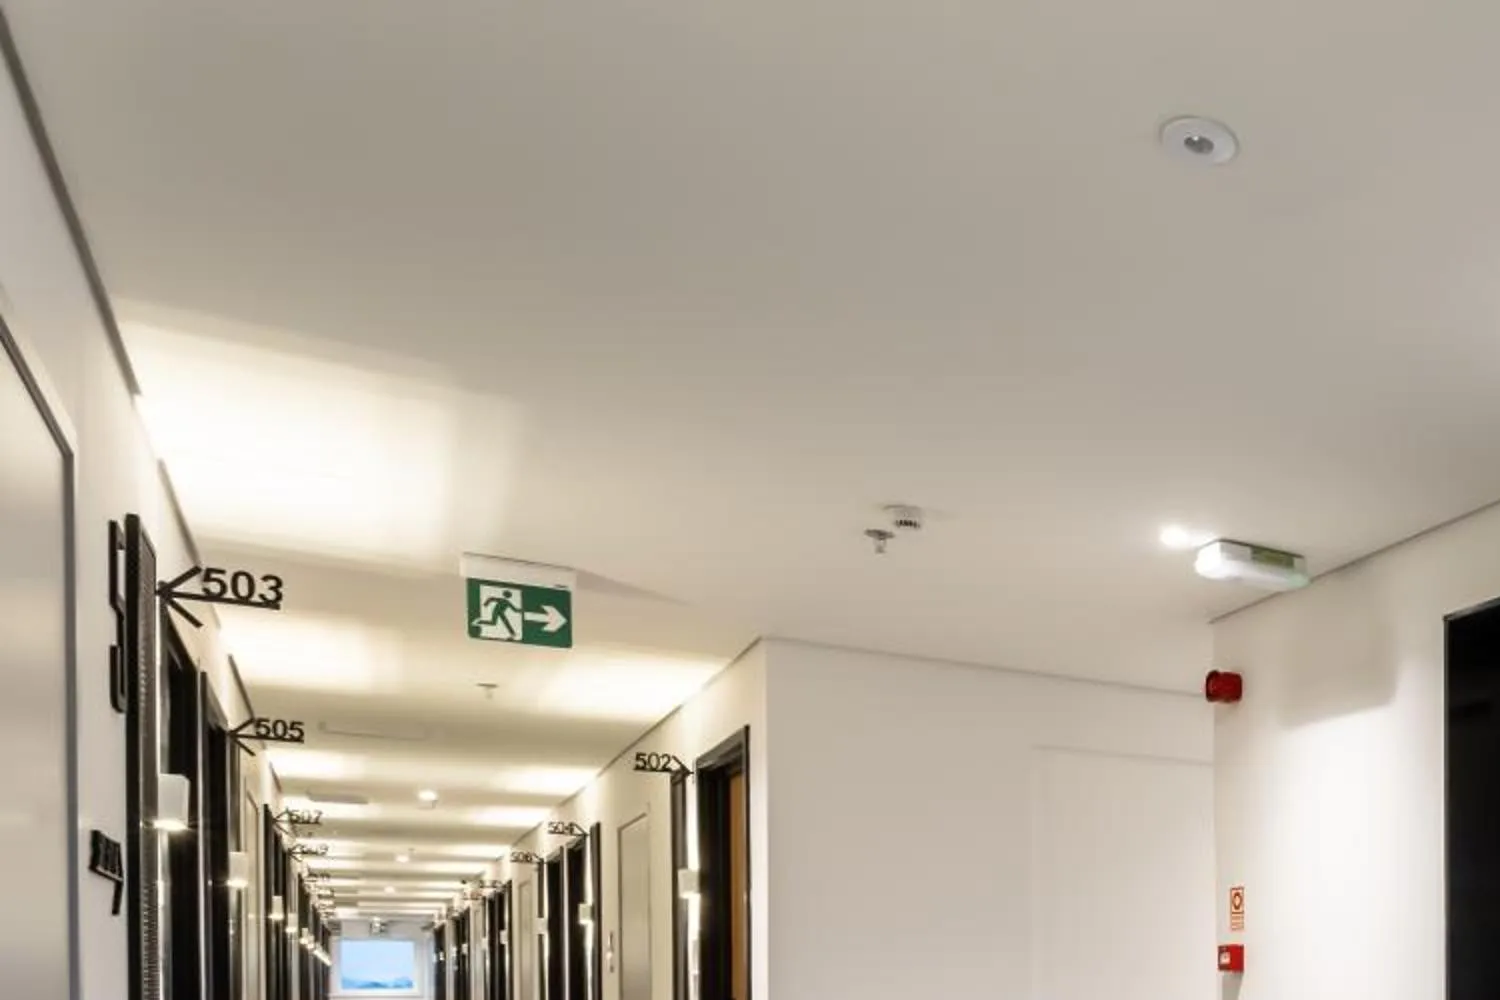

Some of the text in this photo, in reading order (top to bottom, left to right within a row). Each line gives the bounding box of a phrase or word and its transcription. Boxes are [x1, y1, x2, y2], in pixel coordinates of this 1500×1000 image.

[202, 567, 283, 604] 503
[255, 717, 304, 741] 505
[635, 751, 671, 771] 502
